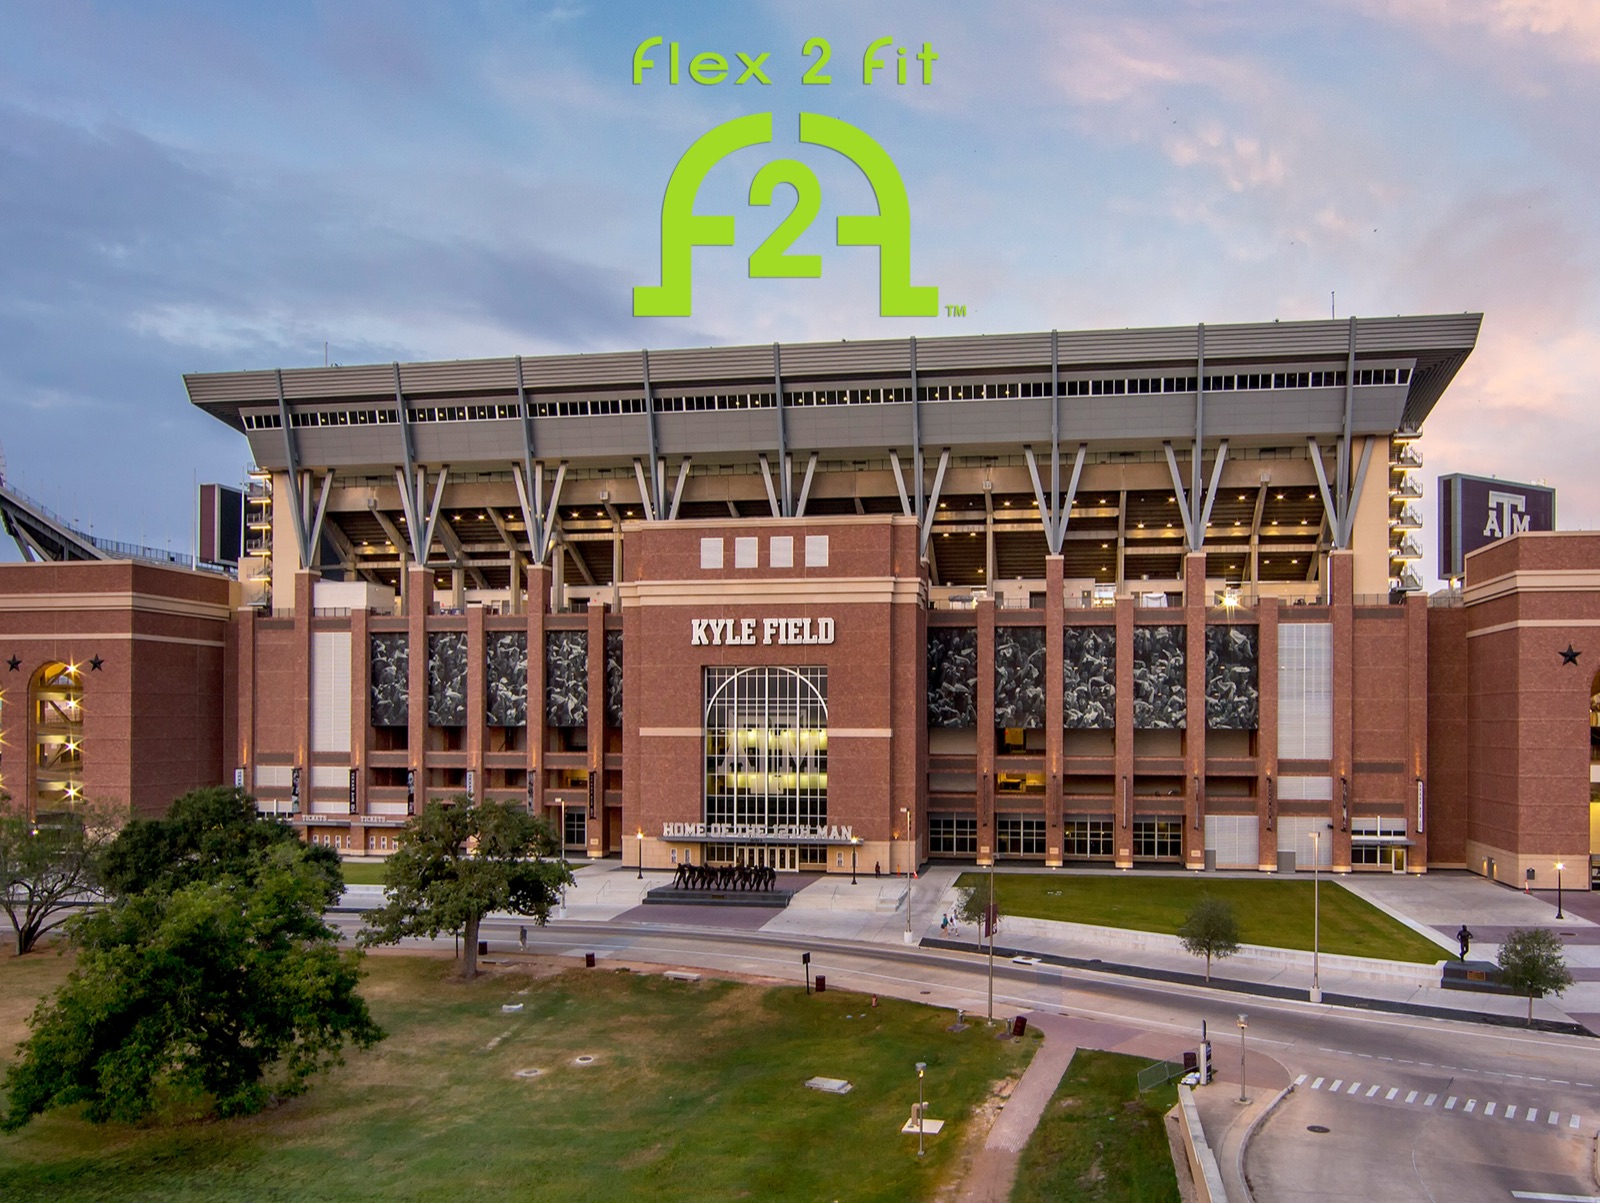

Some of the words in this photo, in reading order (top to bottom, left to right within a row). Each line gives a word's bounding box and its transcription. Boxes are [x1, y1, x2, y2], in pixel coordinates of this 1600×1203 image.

[691, 619, 756, 645] KYLE
[763, 618, 835, 645] FIELD
[302, 814, 327, 822] TICKETS
[360, 815, 386, 823] TICKETS
[663, 822, 707, 837] HOME
[711, 823, 731, 838] OF
[736, 824, 767, 838] THE
[773, 824, 811, 839] 12TH
[816, 825, 852, 840] MAN
